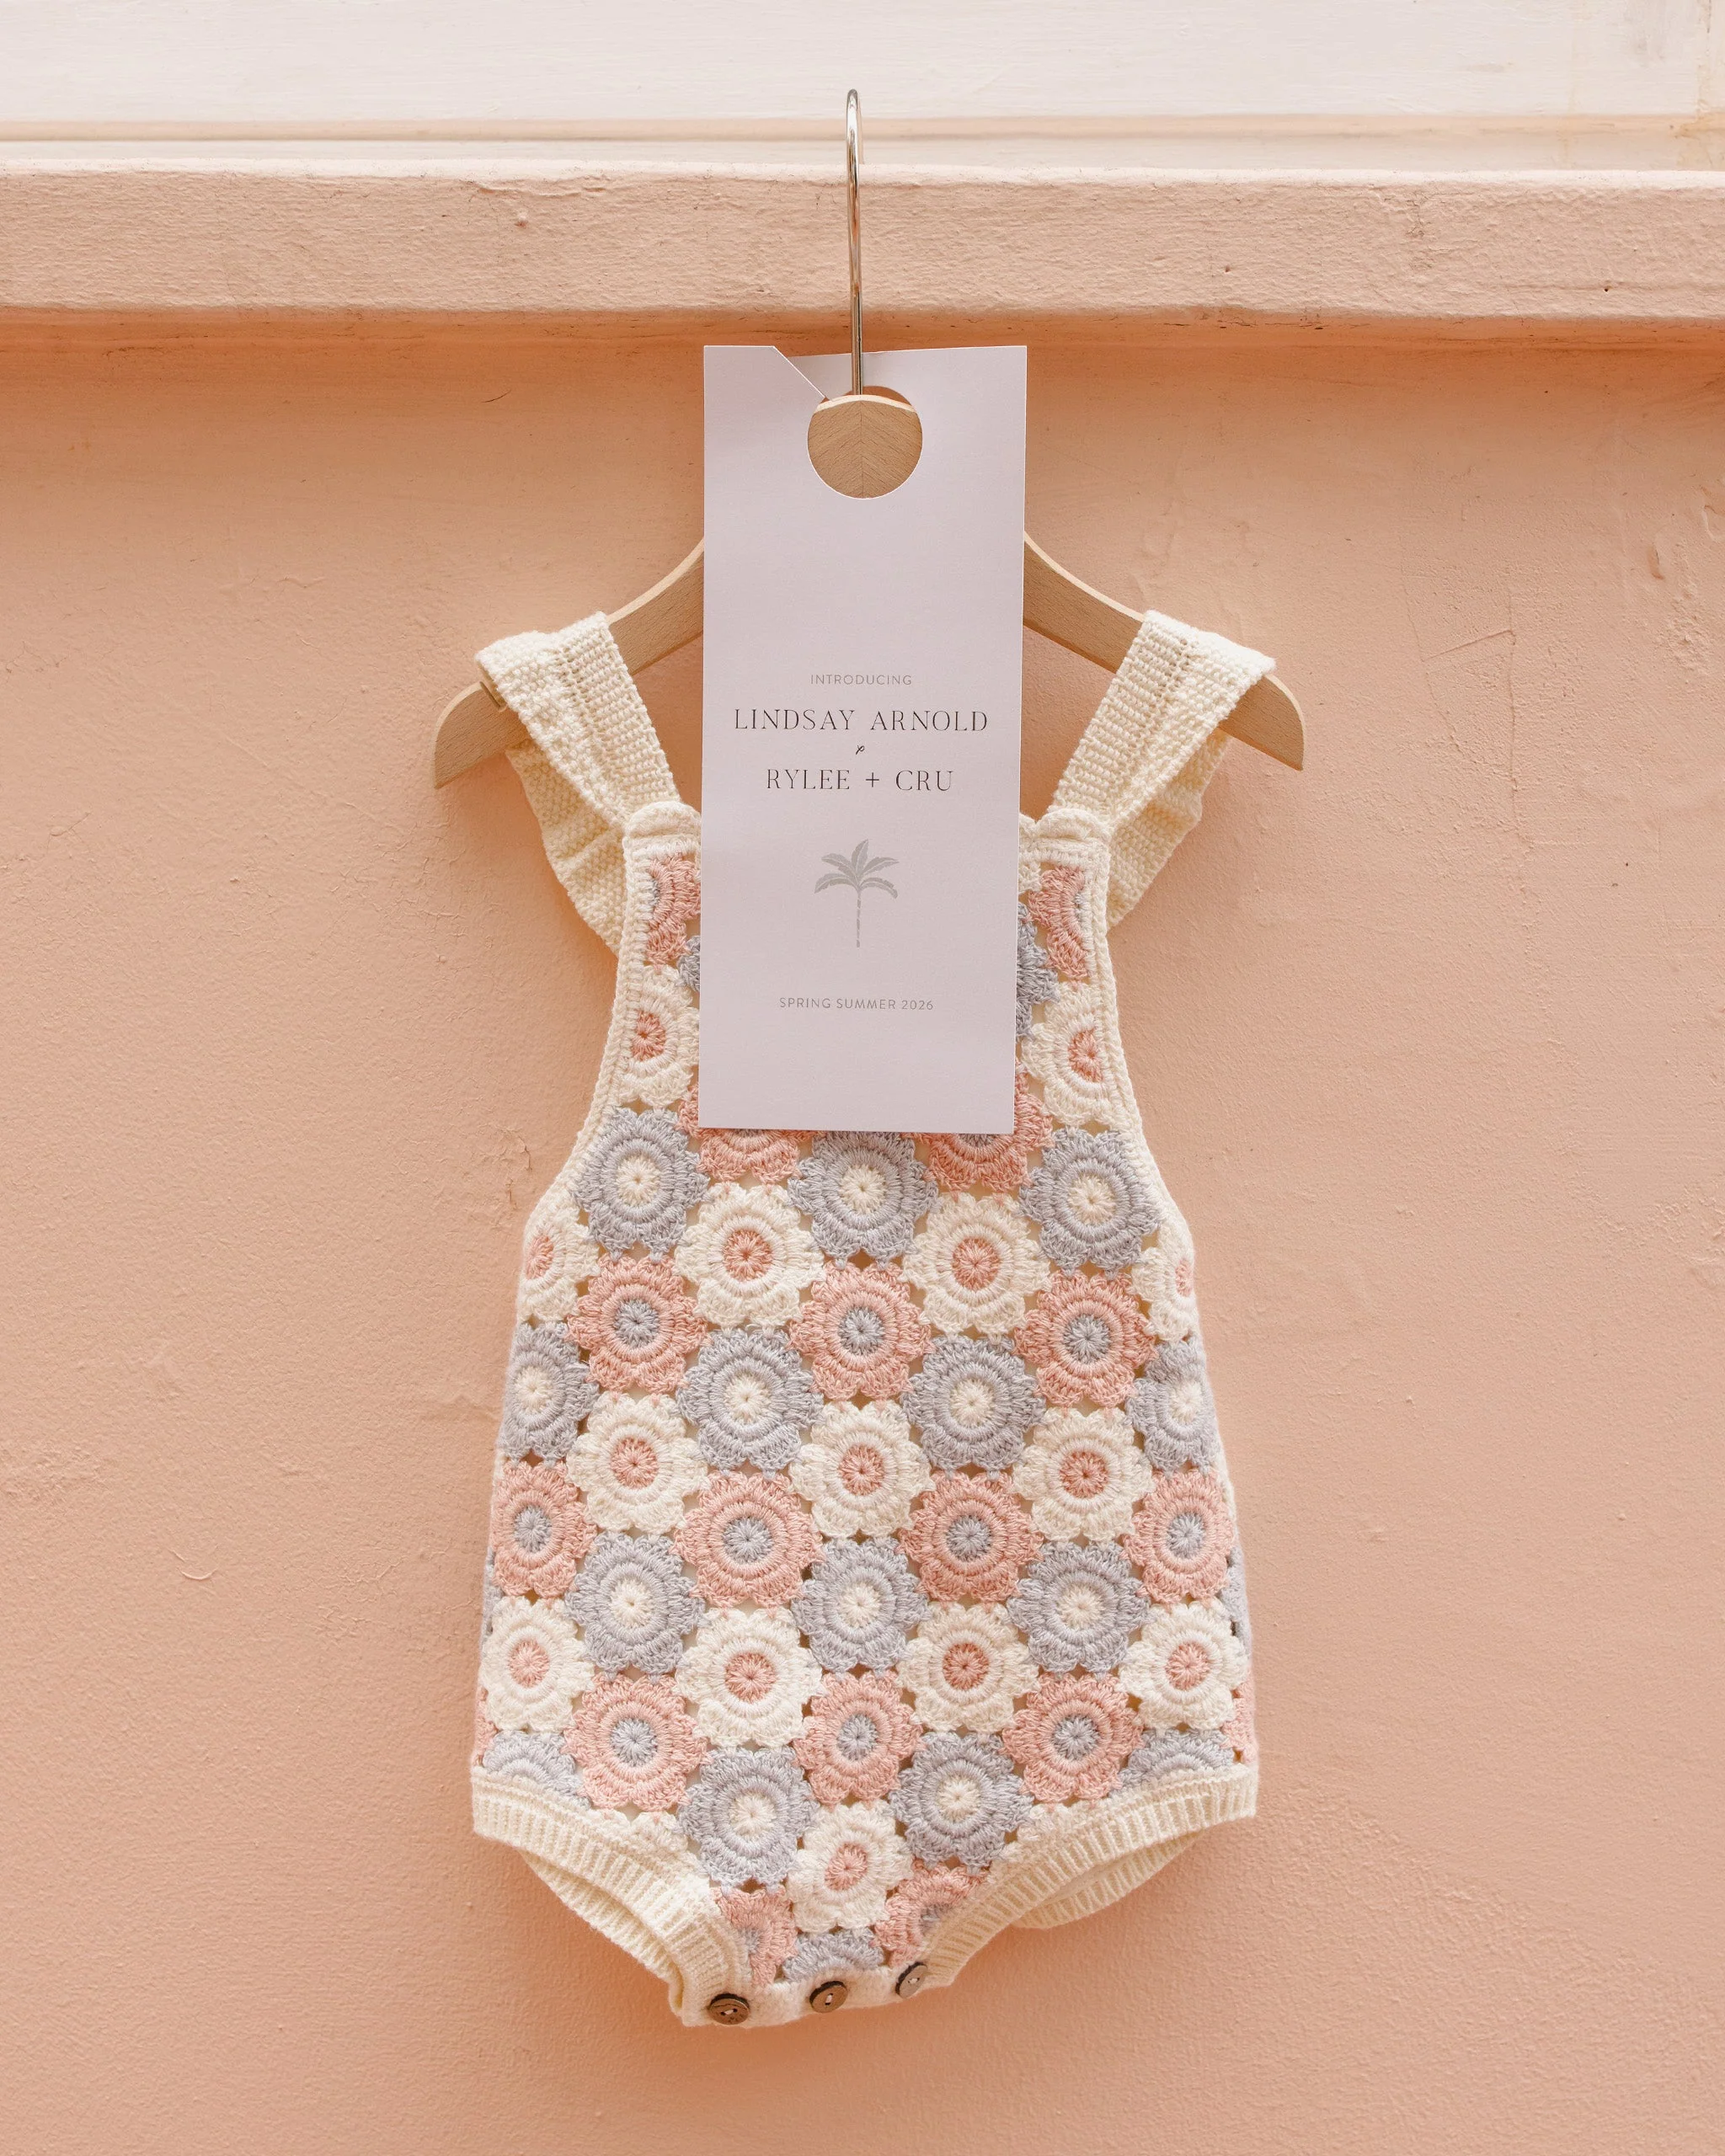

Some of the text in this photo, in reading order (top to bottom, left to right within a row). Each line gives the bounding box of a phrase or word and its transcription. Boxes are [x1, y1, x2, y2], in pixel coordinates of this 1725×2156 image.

[810, 674, 912, 686] INTRODUCING
[734, 708, 988, 732] LINDSAY ARNOLD
[766, 768, 954, 792] RYLEE + CRU
[779, 997, 934, 1011] SPRING SUMMER 2026
